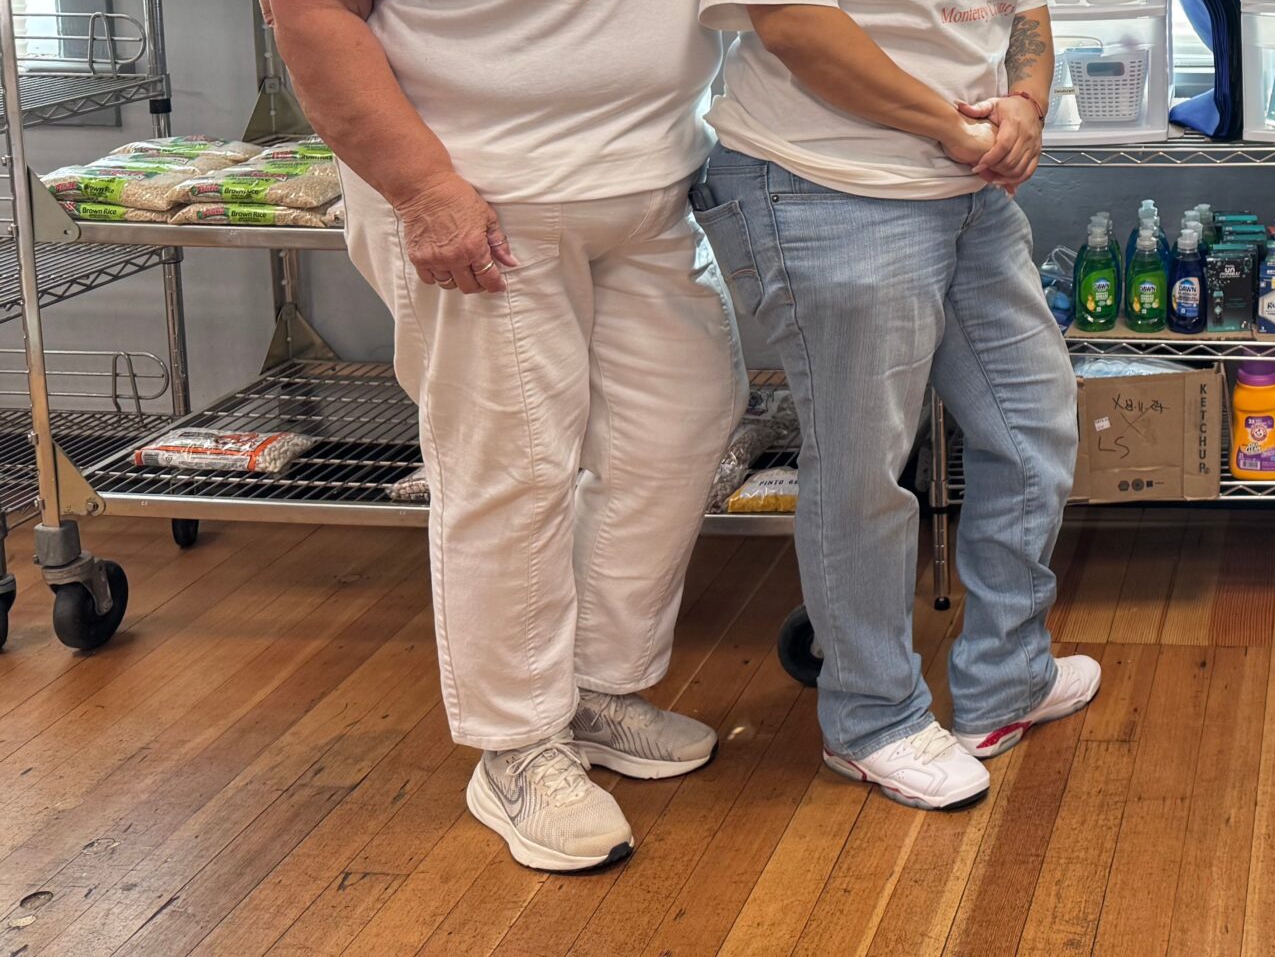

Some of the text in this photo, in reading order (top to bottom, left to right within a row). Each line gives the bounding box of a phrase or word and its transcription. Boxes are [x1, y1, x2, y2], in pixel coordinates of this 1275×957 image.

[941, 6, 990, 25] Monterey
[84, 183, 104, 194] Brown
[82, 207, 103, 215] Brown
[231, 210, 251, 218] Brown
[1199, 383, 1207, 473] KETCHUP
